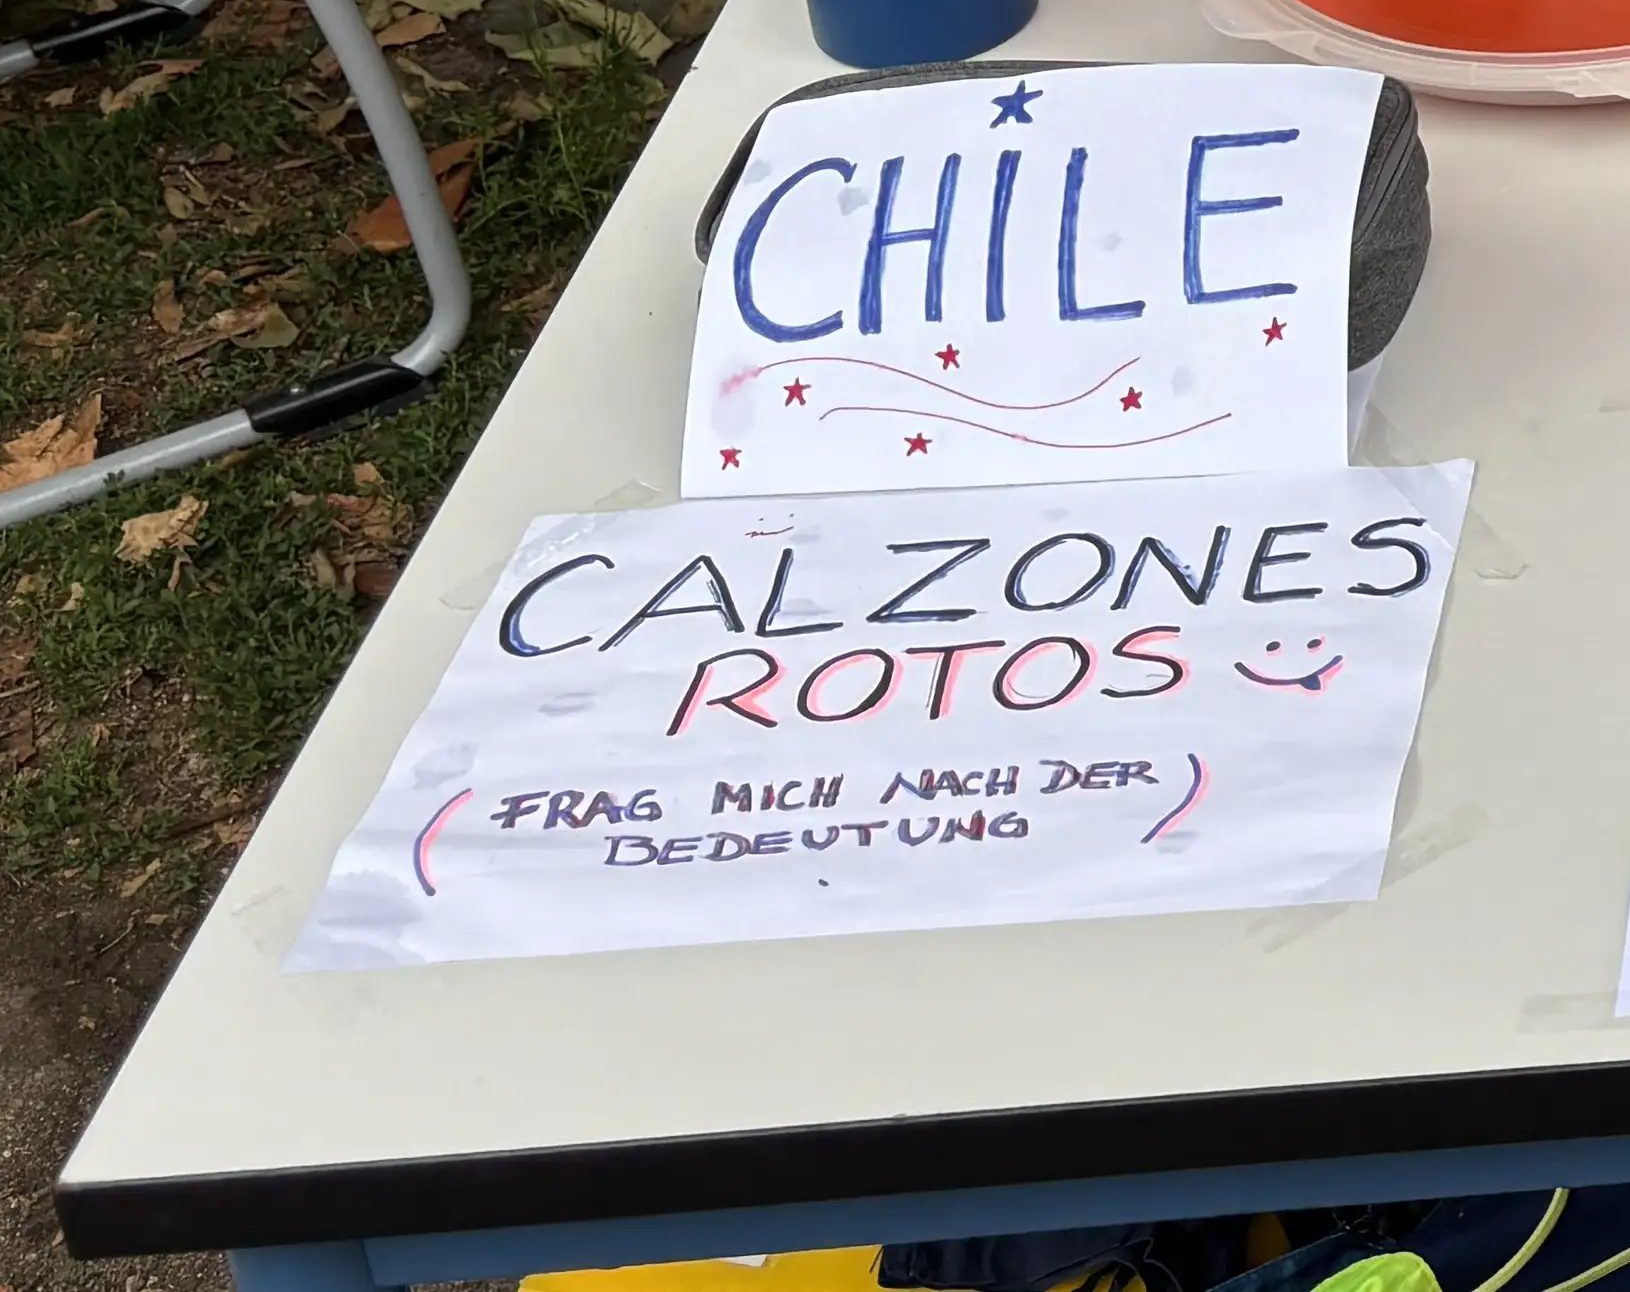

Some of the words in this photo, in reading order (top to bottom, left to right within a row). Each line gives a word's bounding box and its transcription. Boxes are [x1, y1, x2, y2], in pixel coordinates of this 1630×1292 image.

[732, 126, 1299, 344] CHILE
[498, 517, 1430, 662] CALZONES
[666, 625, 1186, 740] ROTOS
[491, 787, 662, 834] FRAG
[712, 772, 843, 814] MICH
[879, 765, 1023, 807] NACH
[1040, 759, 1160, 797] DER
[600, 810, 1031, 870] BEDEUTUNG
